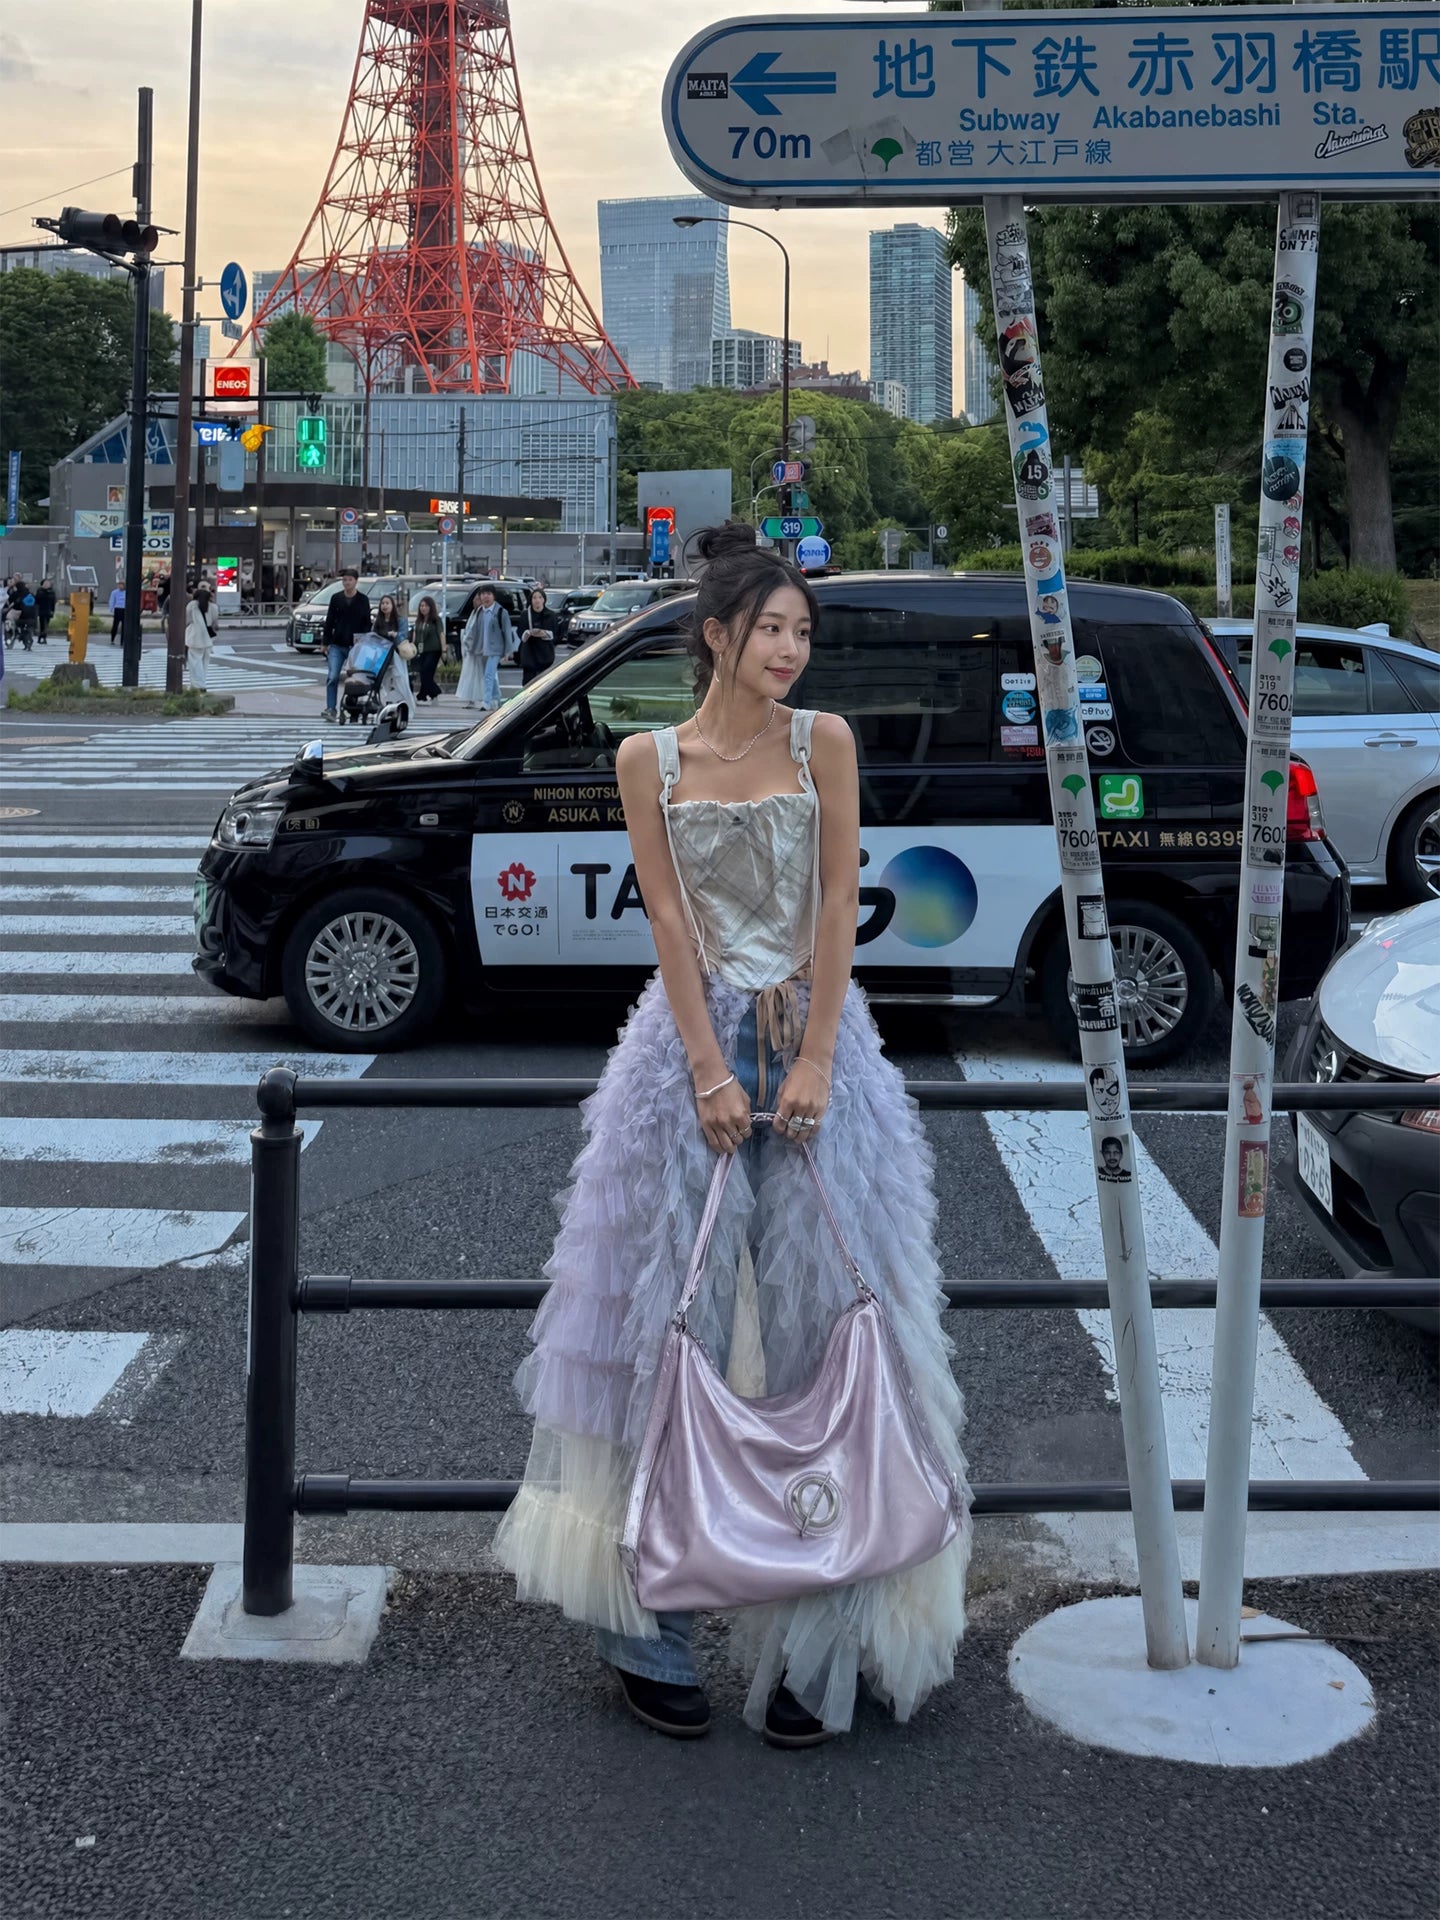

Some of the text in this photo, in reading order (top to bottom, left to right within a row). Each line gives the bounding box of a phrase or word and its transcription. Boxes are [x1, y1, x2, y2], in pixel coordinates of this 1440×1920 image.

[872, 28, 1440, 99] 地下鉄 赤羽橋駅
[688, 80, 727, 91] MAITA
[959, 101, 1366, 135] Subway Akabanebashi Sta.
[728, 126, 811, 160] 70m
[915, 139, 1113, 167] 都営 大江戸線
[216, 380, 247, 389] ENEOS
[1028, 464, 1042, 480] 15
[782, 522, 801, 534] 319
[112, 538, 170, 548] EOS
[534, 787, 620, 800] NIHON KOTSU
[548, 807, 625, 822] ASUKA KO
[1098, 831, 1149, 847] TAXI
[570, 863, 650, 920] TA
[485, 906, 549, 919] 日本交通
[493, 924, 541, 936] でGO!
